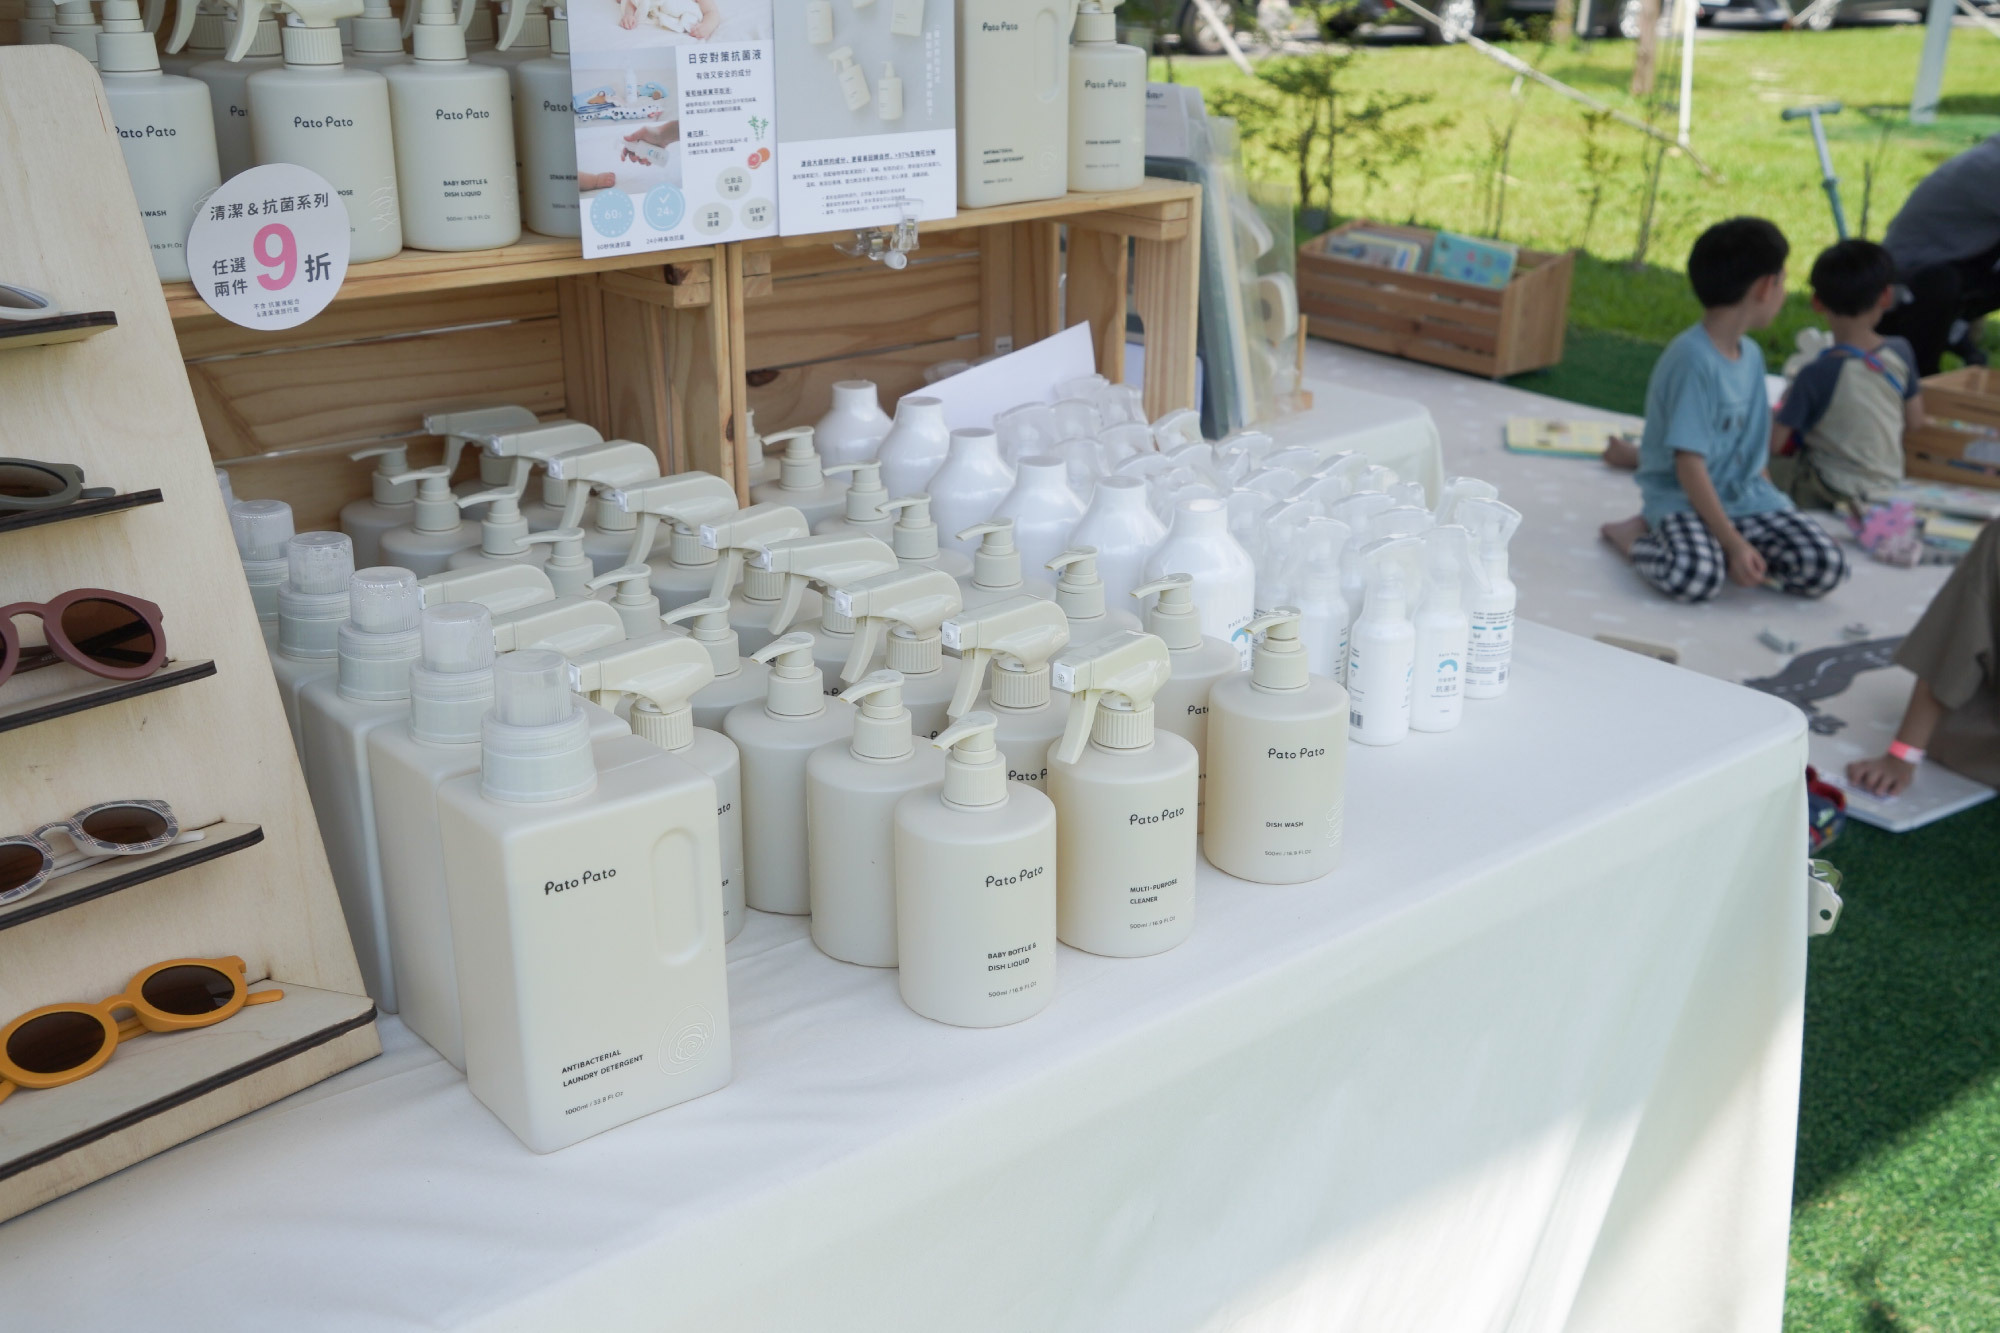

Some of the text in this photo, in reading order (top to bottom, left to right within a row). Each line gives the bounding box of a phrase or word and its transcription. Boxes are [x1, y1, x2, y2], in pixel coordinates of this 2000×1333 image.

[688, 49, 762, 64] 日安對策抗菌液
[543, 100, 568, 112] Pato
[293, 115, 354, 128] Pato Pato
[436, 108, 490, 120] Pato Pato
[146, 125, 177, 138] Pato
[210, 192, 329, 221] 清潔 & 抗菌系列
[253, 223, 298, 291] 9
[212, 256, 247, 276] 任選
[304, 252, 332, 283] 折
[214, 278, 249, 298] 兩件
[1267, 747, 1325, 759] Pato Pato
[1008, 770, 1038, 781] Pato
[717, 803, 731, 816] ato
[1129, 807, 1185, 826] Pato Pato
[544, 868, 617, 896] Pato Pato
[985, 866, 1044, 888] Pato Pato
[1129, 878, 1178, 893] MULTI-PURPOSE
[1129, 896, 1158, 905] CLEANER
[987, 951, 1007, 960] BABY
[1008, 943, 1032, 957] BOTTLE
[988, 957, 1030, 972] DISH LIQUID
[988, 989, 1008, 998] 500ml
[561, 1049, 622, 1074] ANTIBACTERIAL
[563, 1054, 644, 1087] LAUNDRY DETERGENT
[565, 1104, 589, 1116] 1000ml
